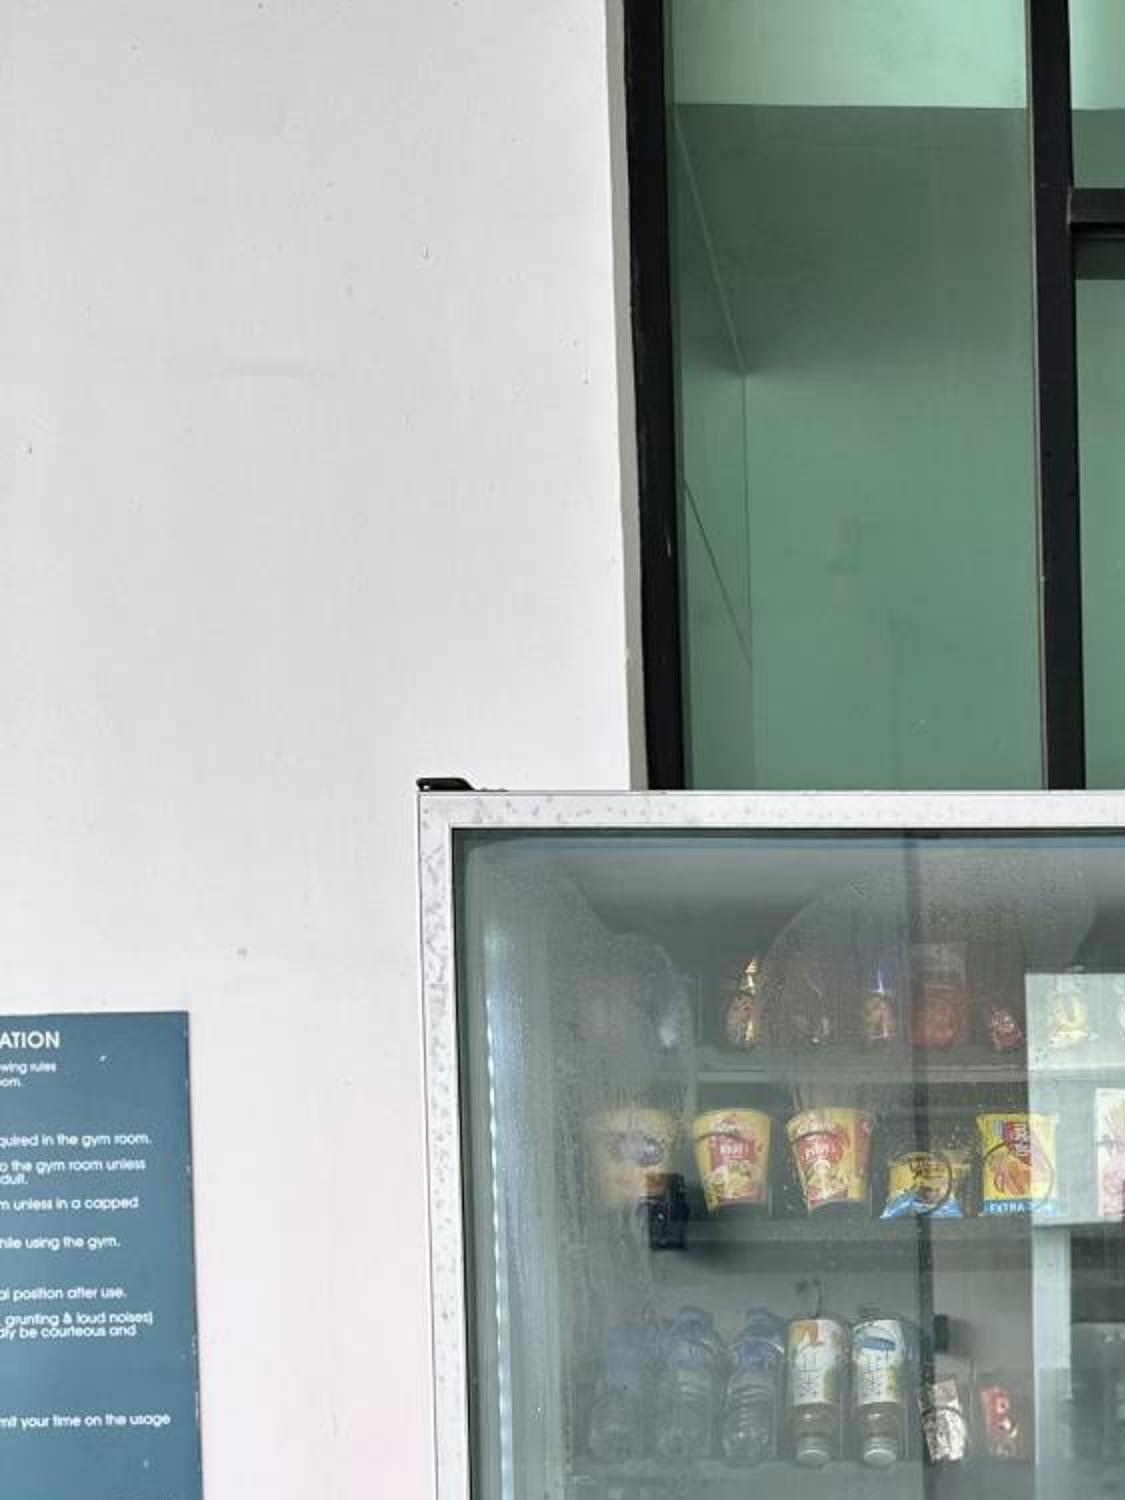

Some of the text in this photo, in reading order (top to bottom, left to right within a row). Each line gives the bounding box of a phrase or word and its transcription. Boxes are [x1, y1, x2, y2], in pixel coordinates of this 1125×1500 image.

[0, 1031, 60, 1049] ATION
[30, 1061, 57, 1073] rules
[42, 1134, 55, 1146] in
[57, 1133, 78, 1145] the
[81, 1135, 111, 1148] gym
[114, 1133, 152, 1145] room.
[11, 1160, 32, 1173] the
[35, 1161, 65, 1175] gym
[69, 1161, 103, 1171] room
[106, 1159, 146, 1171] unless
[13, 1198, 53, 1211] unless
[56, 1197, 68, 1210] in
[71, 1200, 81, 1210] a
[84, 1196, 139, 1212] capped
[25, 1237, 60, 1251] using
[63, 1236, 84, 1247] the
[87, 1237, 121, 1250] gym.
[13, 1288, 64, 1302] position
[67, 1287, 98, 1299] after
[101, 1287, 127, 1299] use.
[5, 1313, 59, 1328] grunting
[62, 1313, 72, 1324] &
[76, 1312, 106, 1324] loud
[19, 1327, 38, 1338] be
[40, 1325, 106, 1338] courteous
[109, 1324, 137, 1337] and
[21, 1417, 50, 1431] your
[52, 1414, 81, 1427] time
[84, 1416, 102, 1426] on
[105, 1413, 126, 1425] the
[129, 1414, 171, 1428] usage
